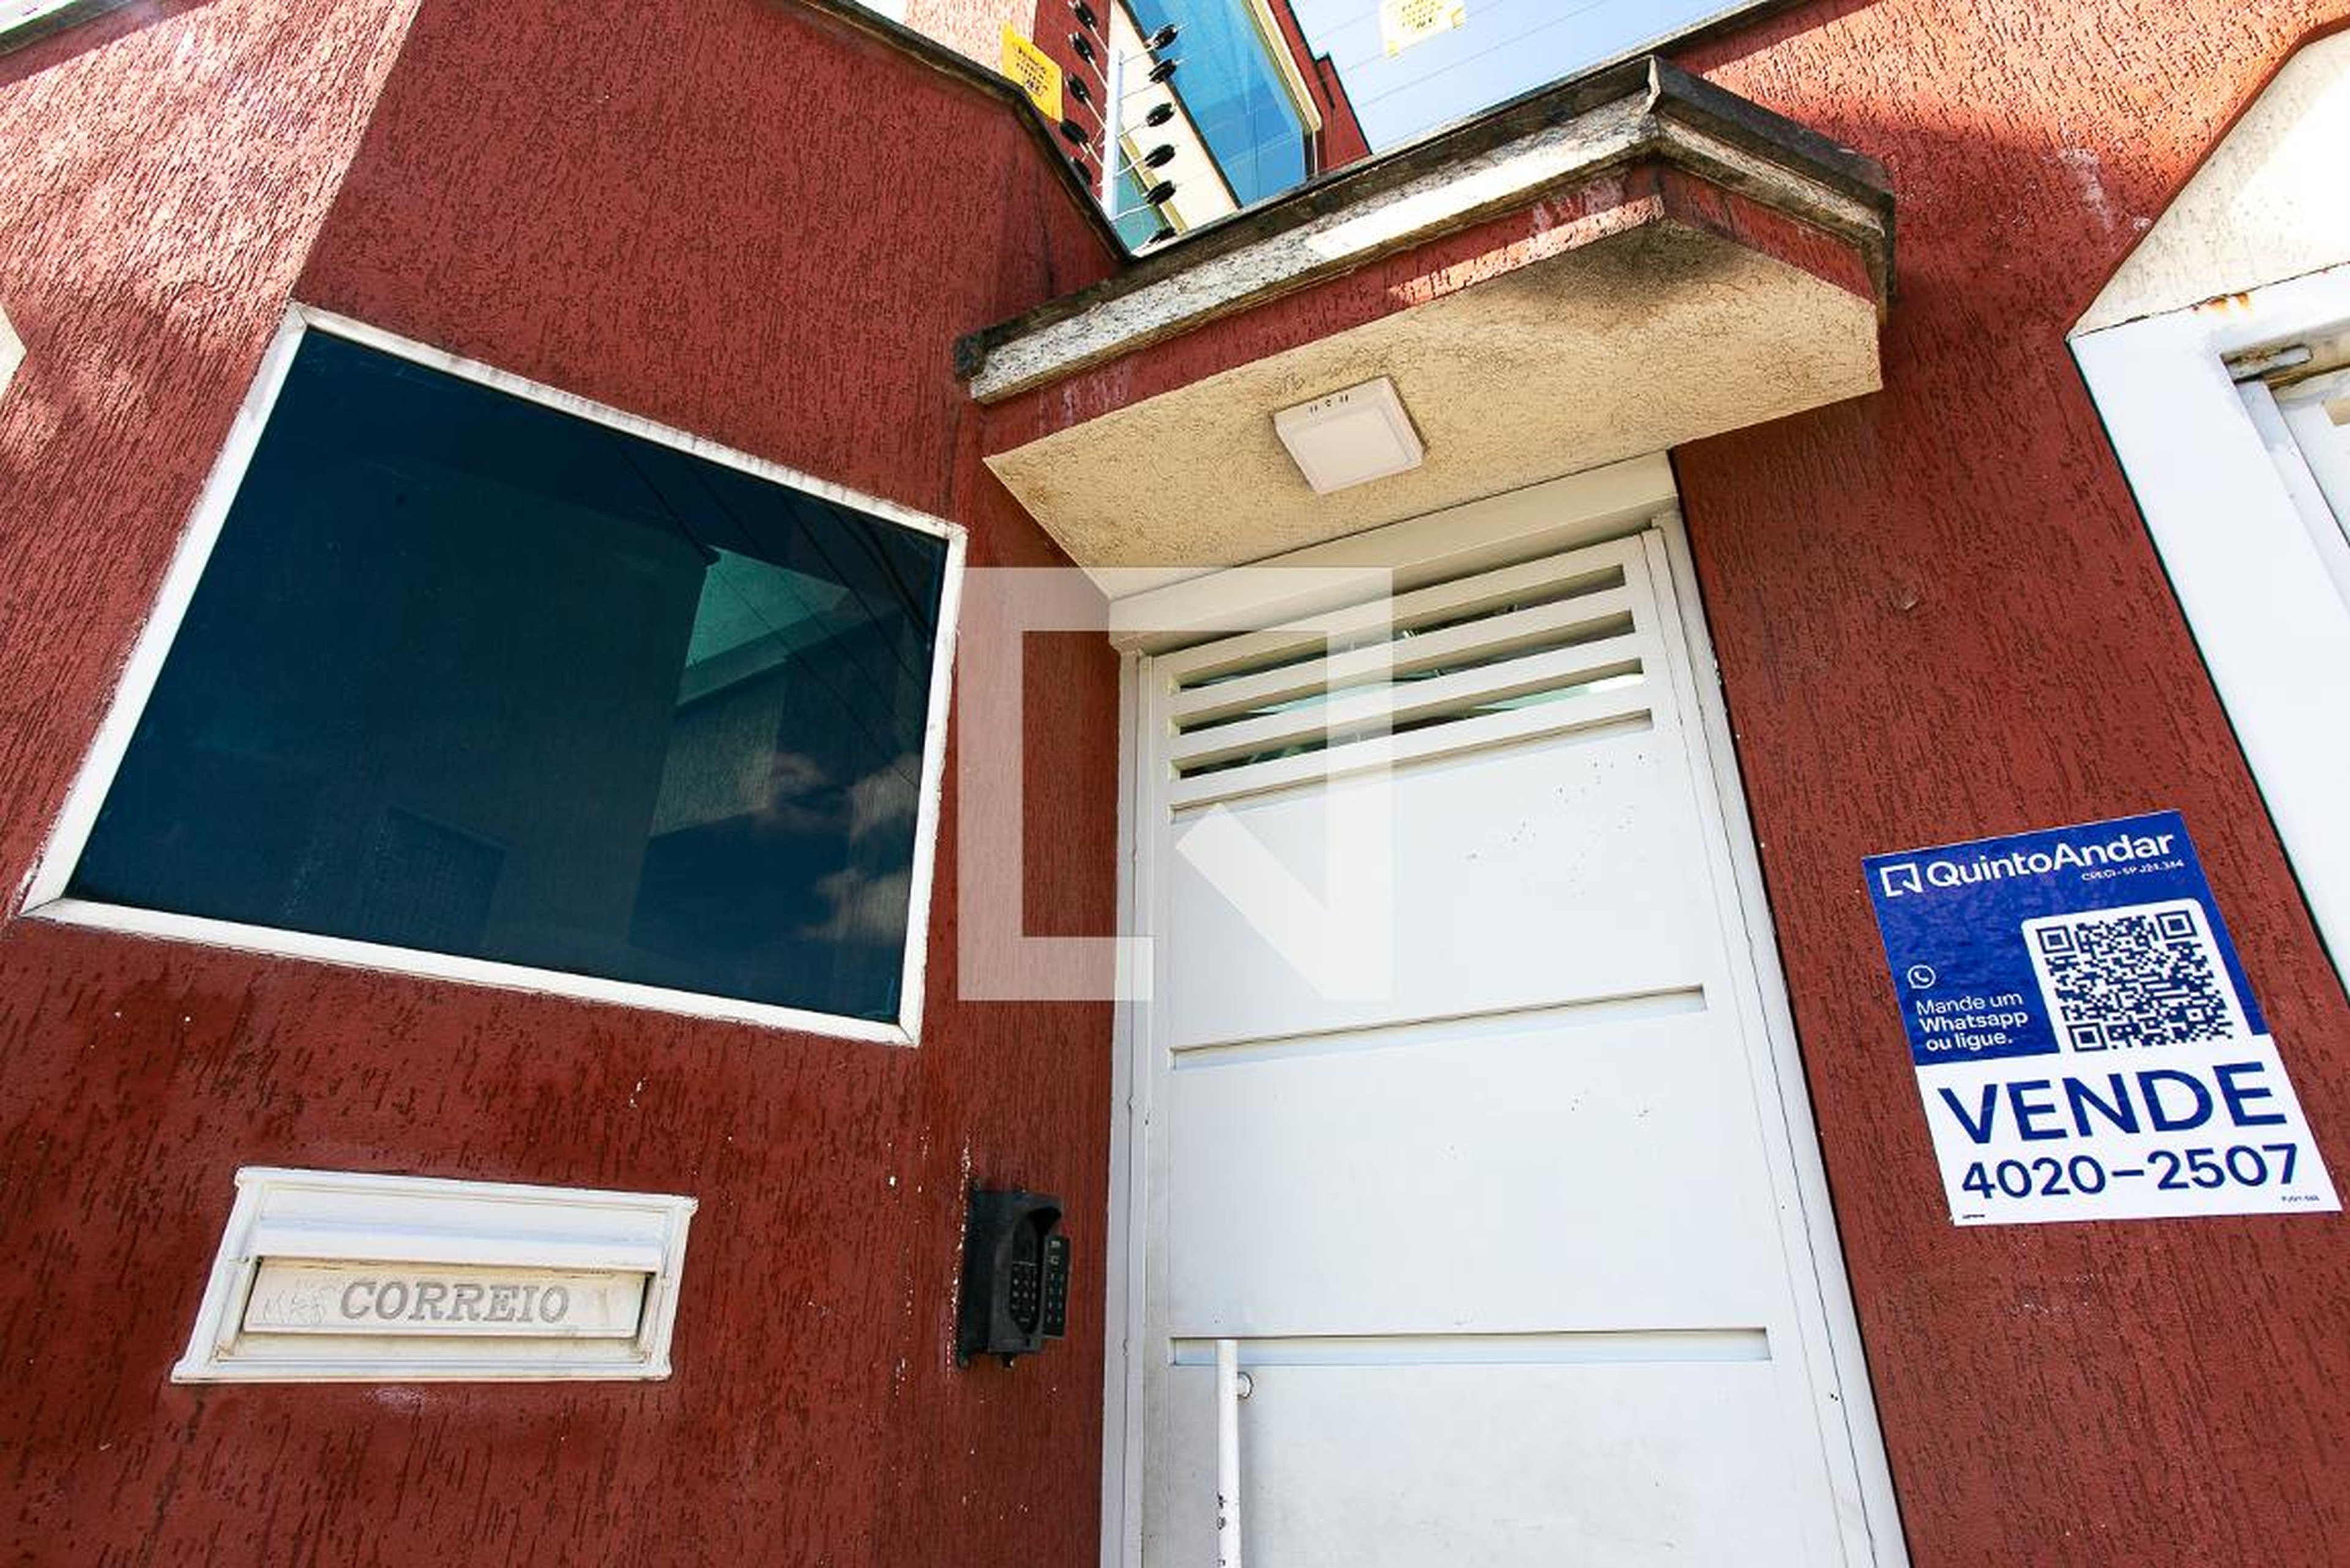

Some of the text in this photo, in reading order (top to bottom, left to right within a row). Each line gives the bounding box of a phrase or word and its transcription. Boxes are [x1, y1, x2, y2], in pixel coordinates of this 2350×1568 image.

[1927, 834, 2174, 887] QuintoAndar
[1916, 993, 2024, 1015] Mande um
[1919, 1011, 2029, 1033] Whatsapp
[1927, 1032, 2013, 1051] ou ligue.
[1938, 1061, 2288, 1144] VENDE
[1961, 1143, 2298, 1198] 4020-2507
[340, 1281, 570, 1323] CORREIO
